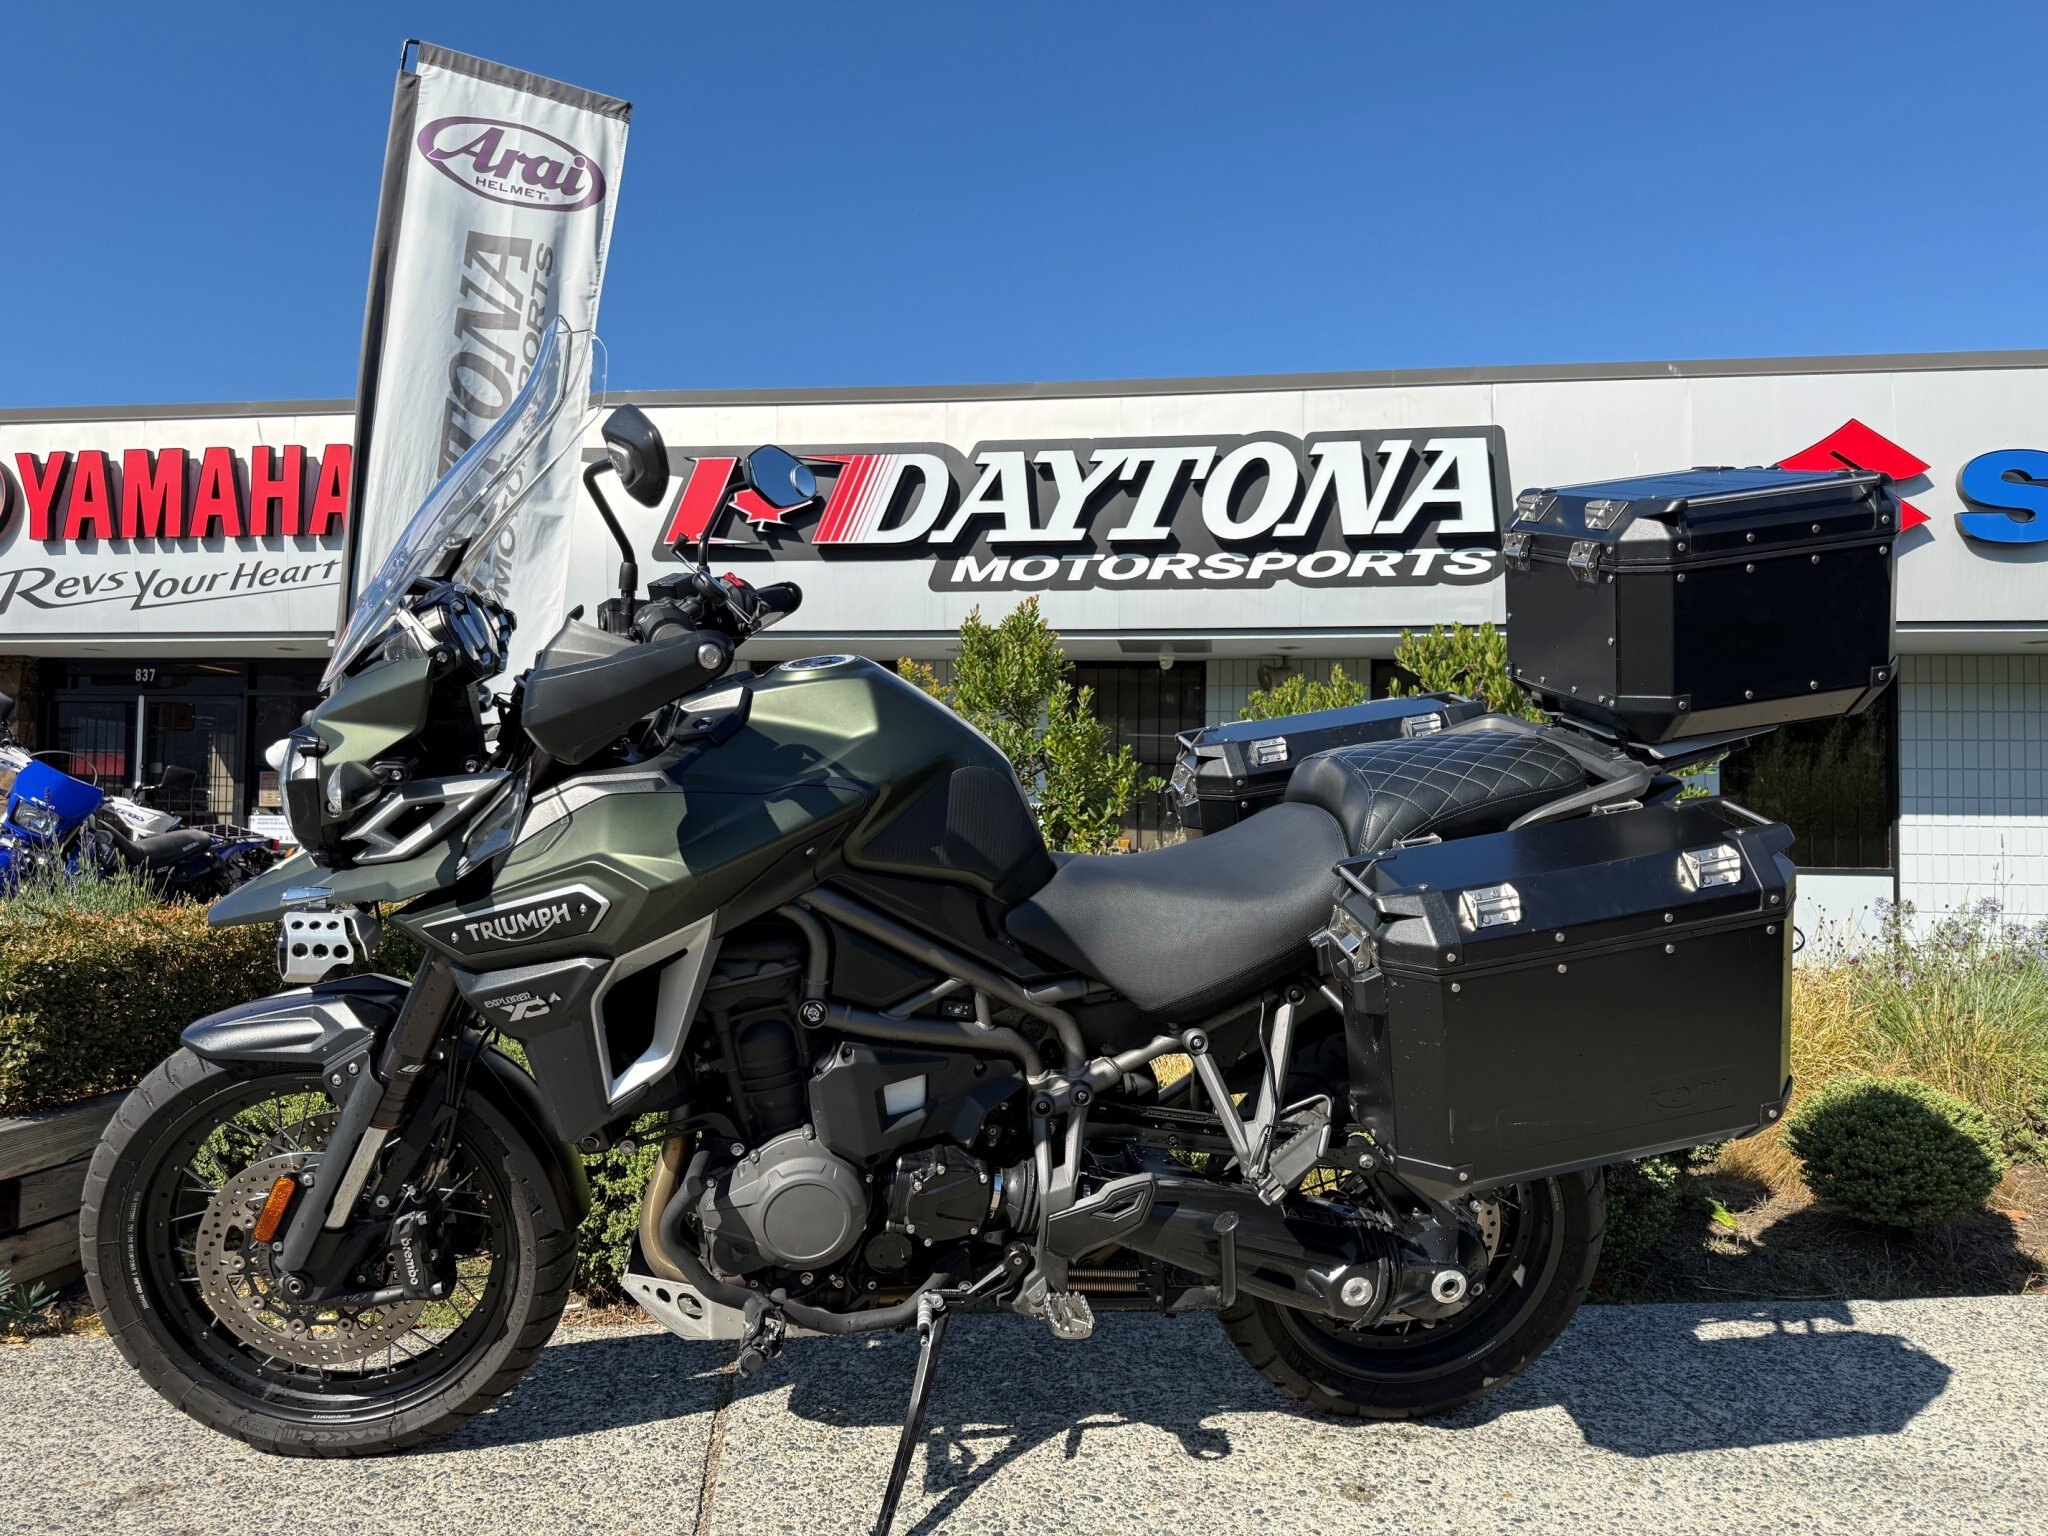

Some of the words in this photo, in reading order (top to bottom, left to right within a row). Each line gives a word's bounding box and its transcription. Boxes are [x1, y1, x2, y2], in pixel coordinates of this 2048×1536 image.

[427, 127, 586, 196] Arai
[475, 176, 546, 200] HELMET
[15, 444, 351, 541] YAMAHA
[868, 437, 1494, 545] DAYTONA
[1956, 449, 2048, 544] S
[0, 567, 128, 614] Revs
[130, 568, 229, 611] Your
[230, 558, 341, 591] Heart
[952, 548, 1496, 586] MOTORSPORTS
[135, 668, 156, 682] 837
[465, 903, 571, 942] TRIUMPH
[484, 991, 532, 1009] EXPLORER
[401, 1237, 420, 1286] brembo
